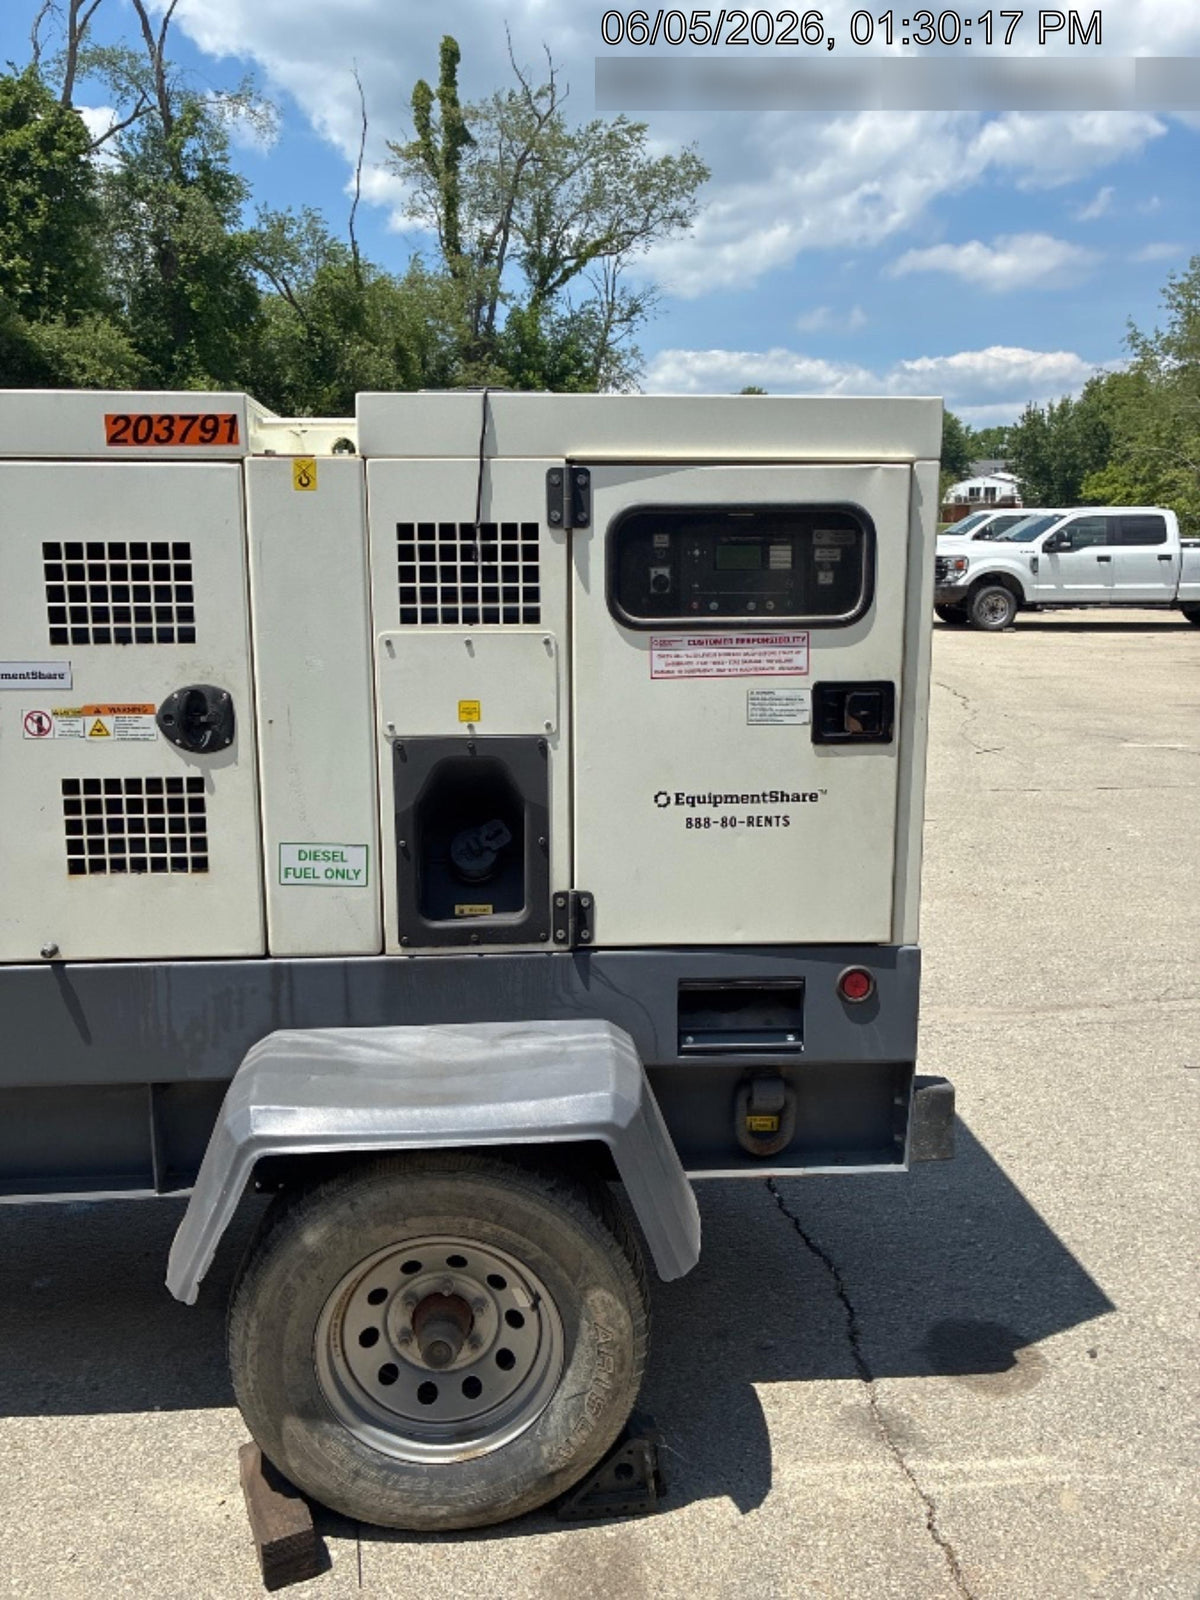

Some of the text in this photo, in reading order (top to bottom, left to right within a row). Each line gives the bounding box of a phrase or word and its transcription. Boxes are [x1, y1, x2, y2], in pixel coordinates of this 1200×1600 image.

[108, 414, 238, 444] 203791
[685, 815, 791, 829] 888-80-RENTS
[297, 849, 348, 863] DIESEL
[284, 866, 361, 881] FUEL ONLY
